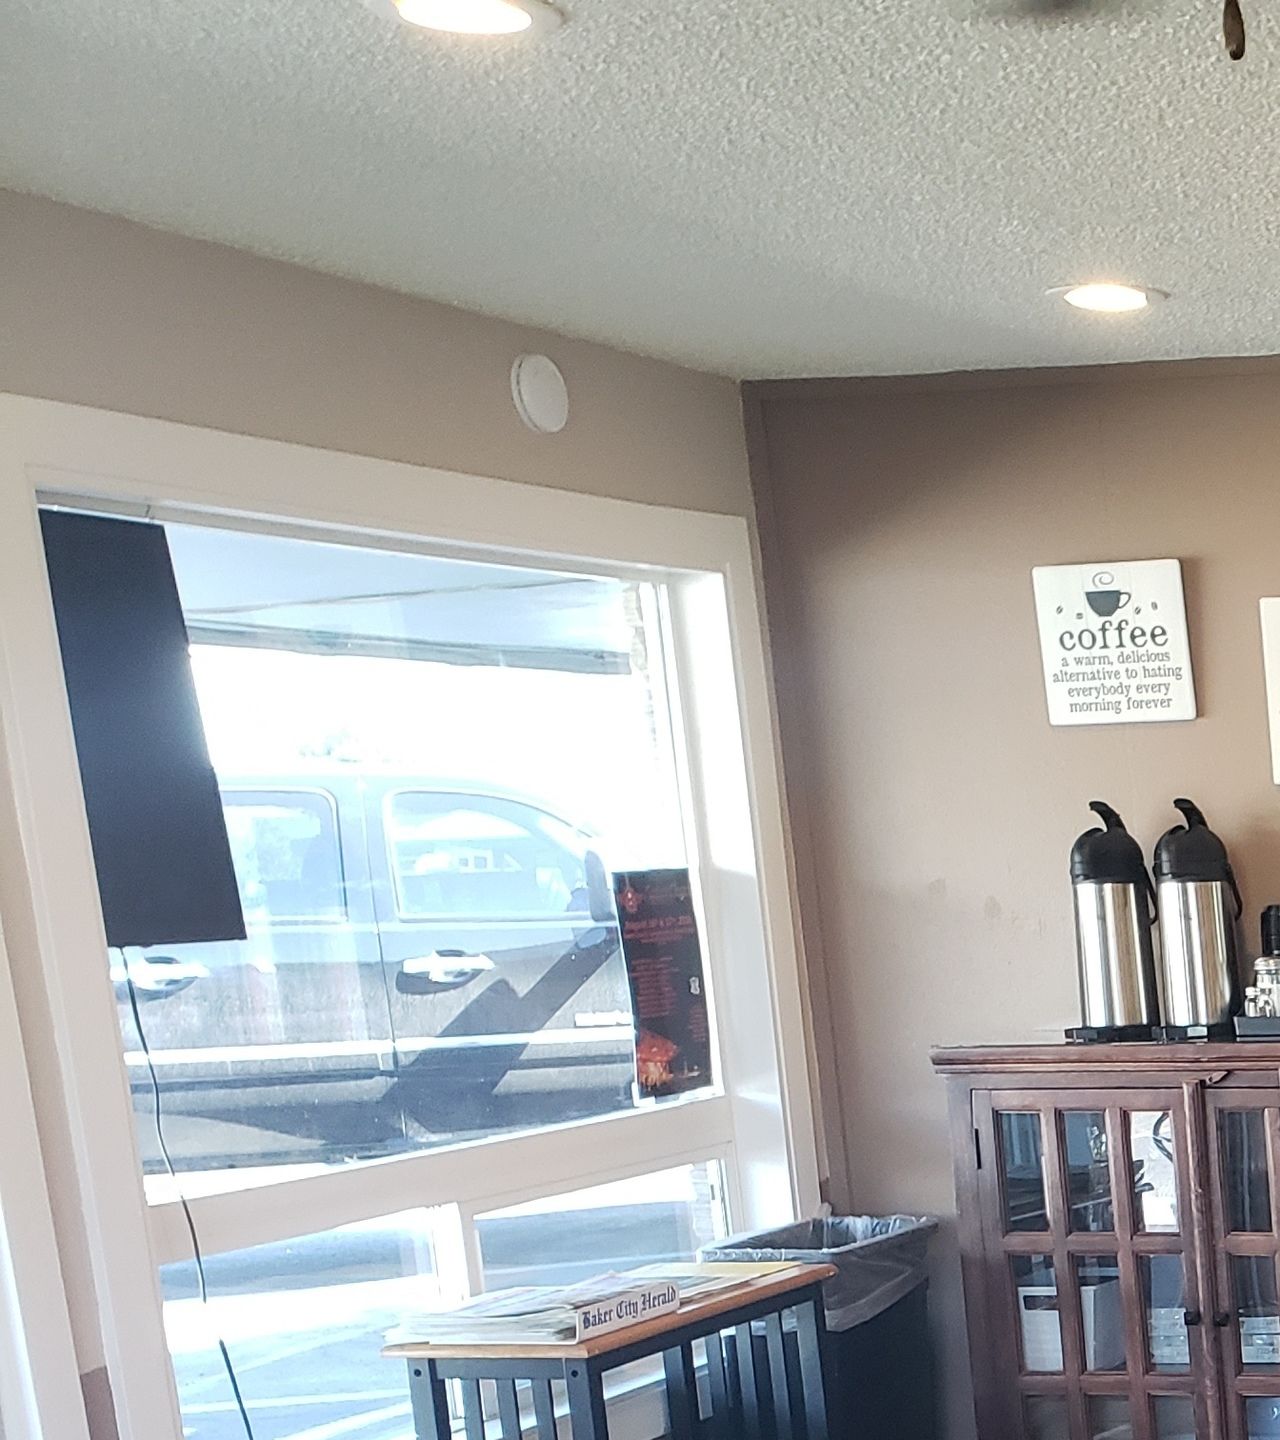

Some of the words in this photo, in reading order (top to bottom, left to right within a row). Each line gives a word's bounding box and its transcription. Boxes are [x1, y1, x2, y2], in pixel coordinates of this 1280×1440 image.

[1059, 619, 1168, 651] coffee
[1062, 656, 1069, 667] a
[1074, 654, 1113, 666] warm,
[1117, 650, 1171, 664] delicious
[1053, 667, 1121, 683] alternative
[1125, 667, 1138, 679] to
[1142, 664, 1182, 680] hating
[1068, 682, 1131, 699] everybody
[1136, 682, 1171, 695] every
[1070, 699, 1122, 714] morning
[1126, 697, 1173, 710] forever
[582, 1307, 614, 1330] Baker
[616, 1299, 639, 1319] City
[641, 1285, 677, 1312] Herald
